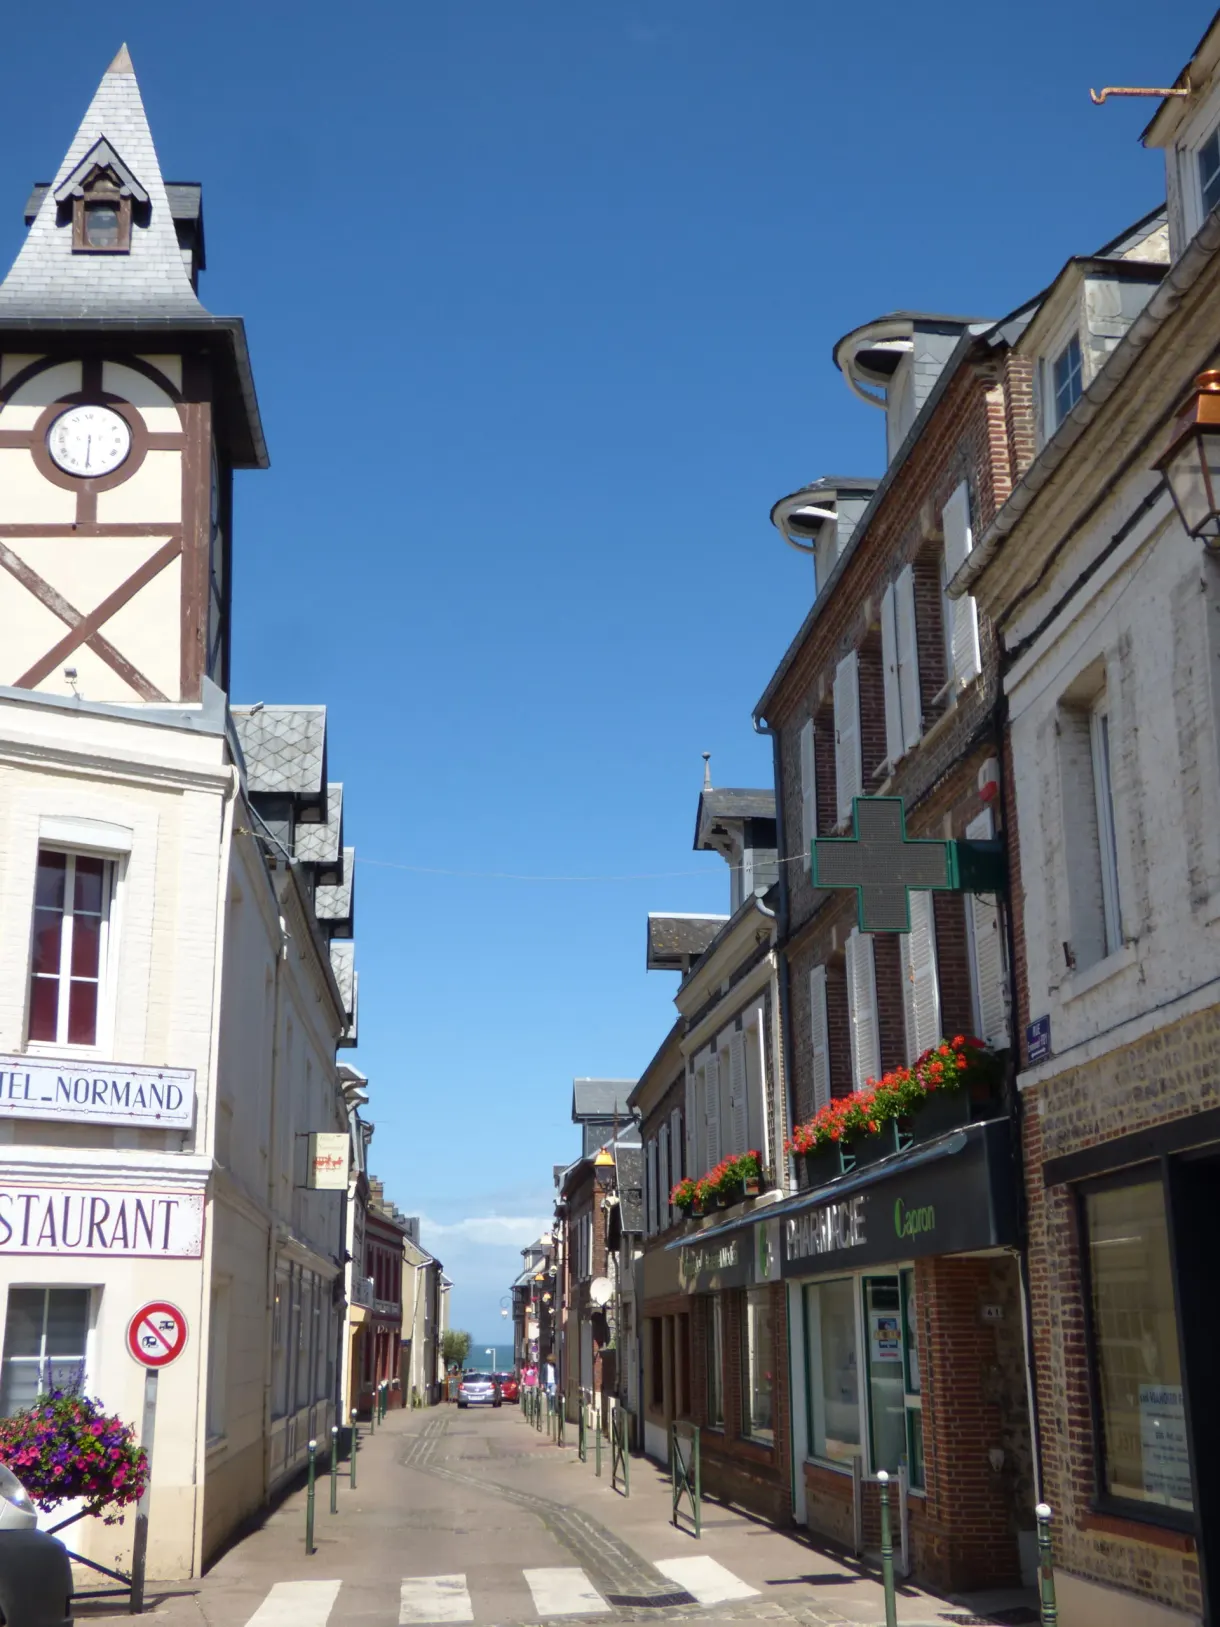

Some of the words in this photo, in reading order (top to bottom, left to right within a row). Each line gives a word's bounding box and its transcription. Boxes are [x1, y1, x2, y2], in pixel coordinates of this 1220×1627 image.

[55, 1076, 183, 1111] NORMAND
[786, 1196, 867, 1261] PHARMACIE
[894, 1197, 936, 1243] Capron
